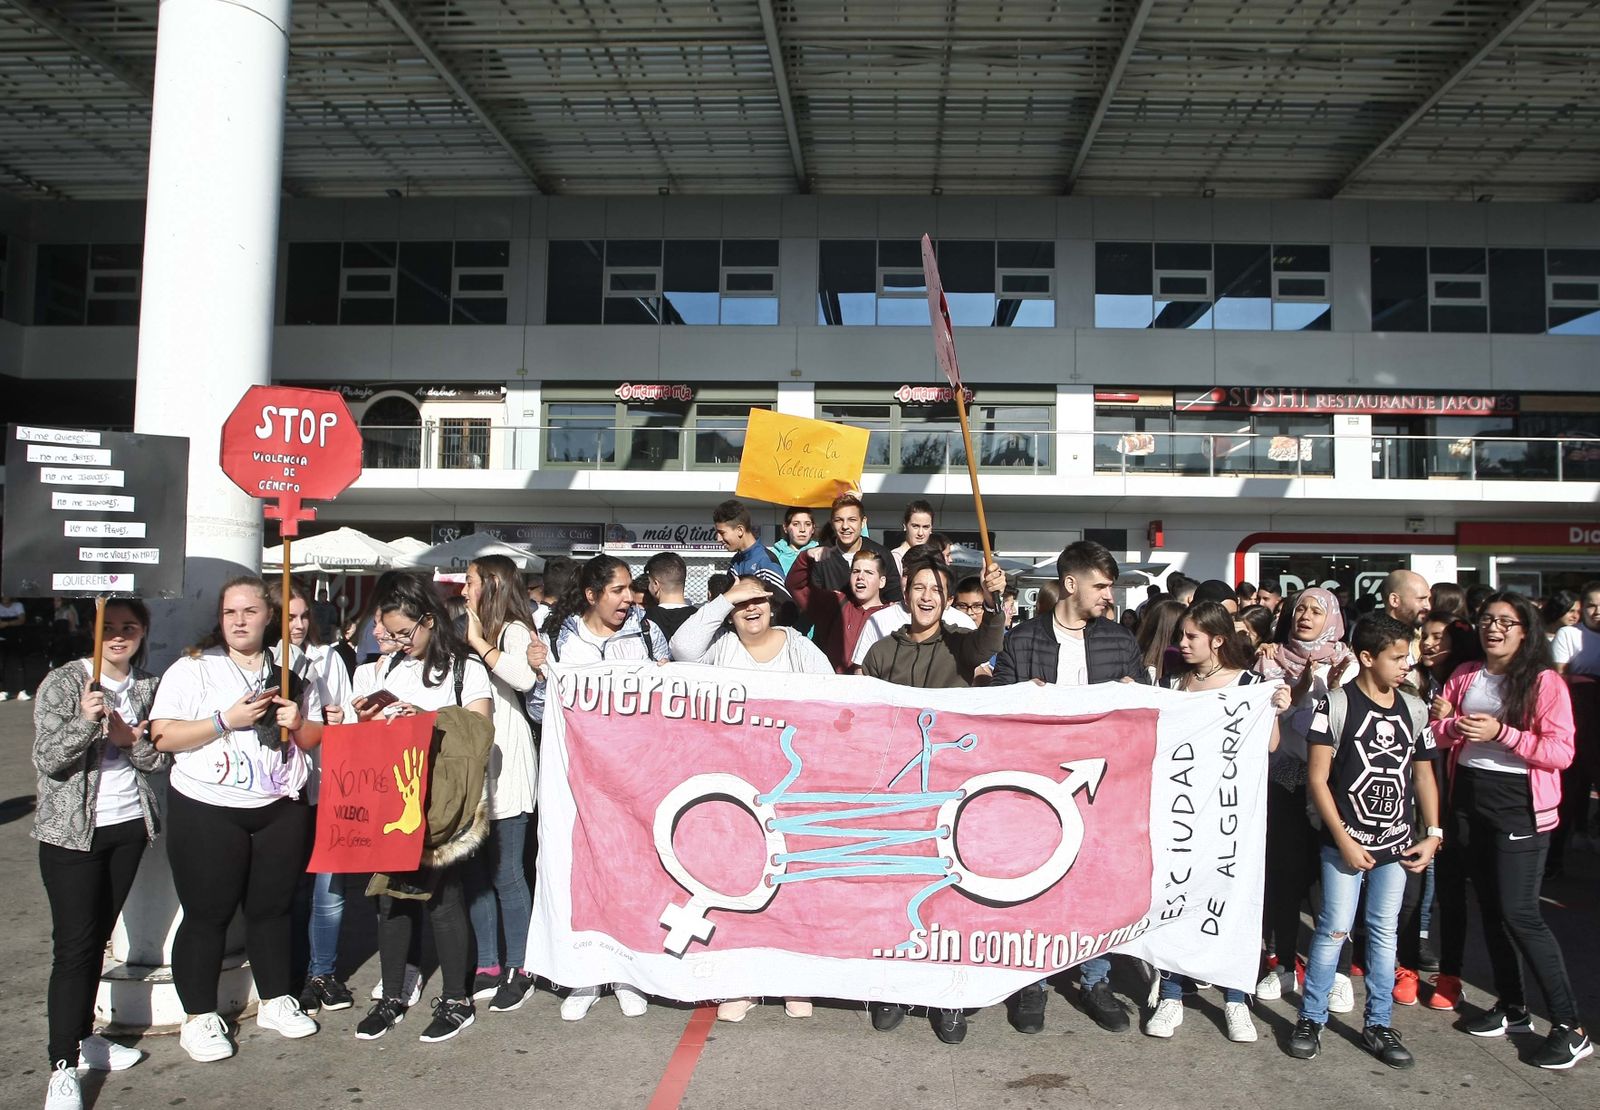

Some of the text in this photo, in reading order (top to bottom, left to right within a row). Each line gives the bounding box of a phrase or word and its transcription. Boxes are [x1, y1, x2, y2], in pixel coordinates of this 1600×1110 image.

[1229, 387, 1514, 412] SUSHI RESTAURANTE JAPONÉS
[34, 432, 49, 440] me
[255, 405, 338, 448] STOP
[776, 427, 841, 459] No a la
[283, 467, 296, 477] DE
[773, 456, 826, 480] Violencia
[56, 498, 67, 506] no
[86, 525, 98, 533] me
[569, 528, 593, 540] Café
[642, 525, 673, 541] más
[674, 524, 689, 545] Q
[81, 551, 93, 559] no
[96, 551, 108, 559] me
[1200, 897, 1226, 936] DE
[968, 916, 1150, 969] controlarme
